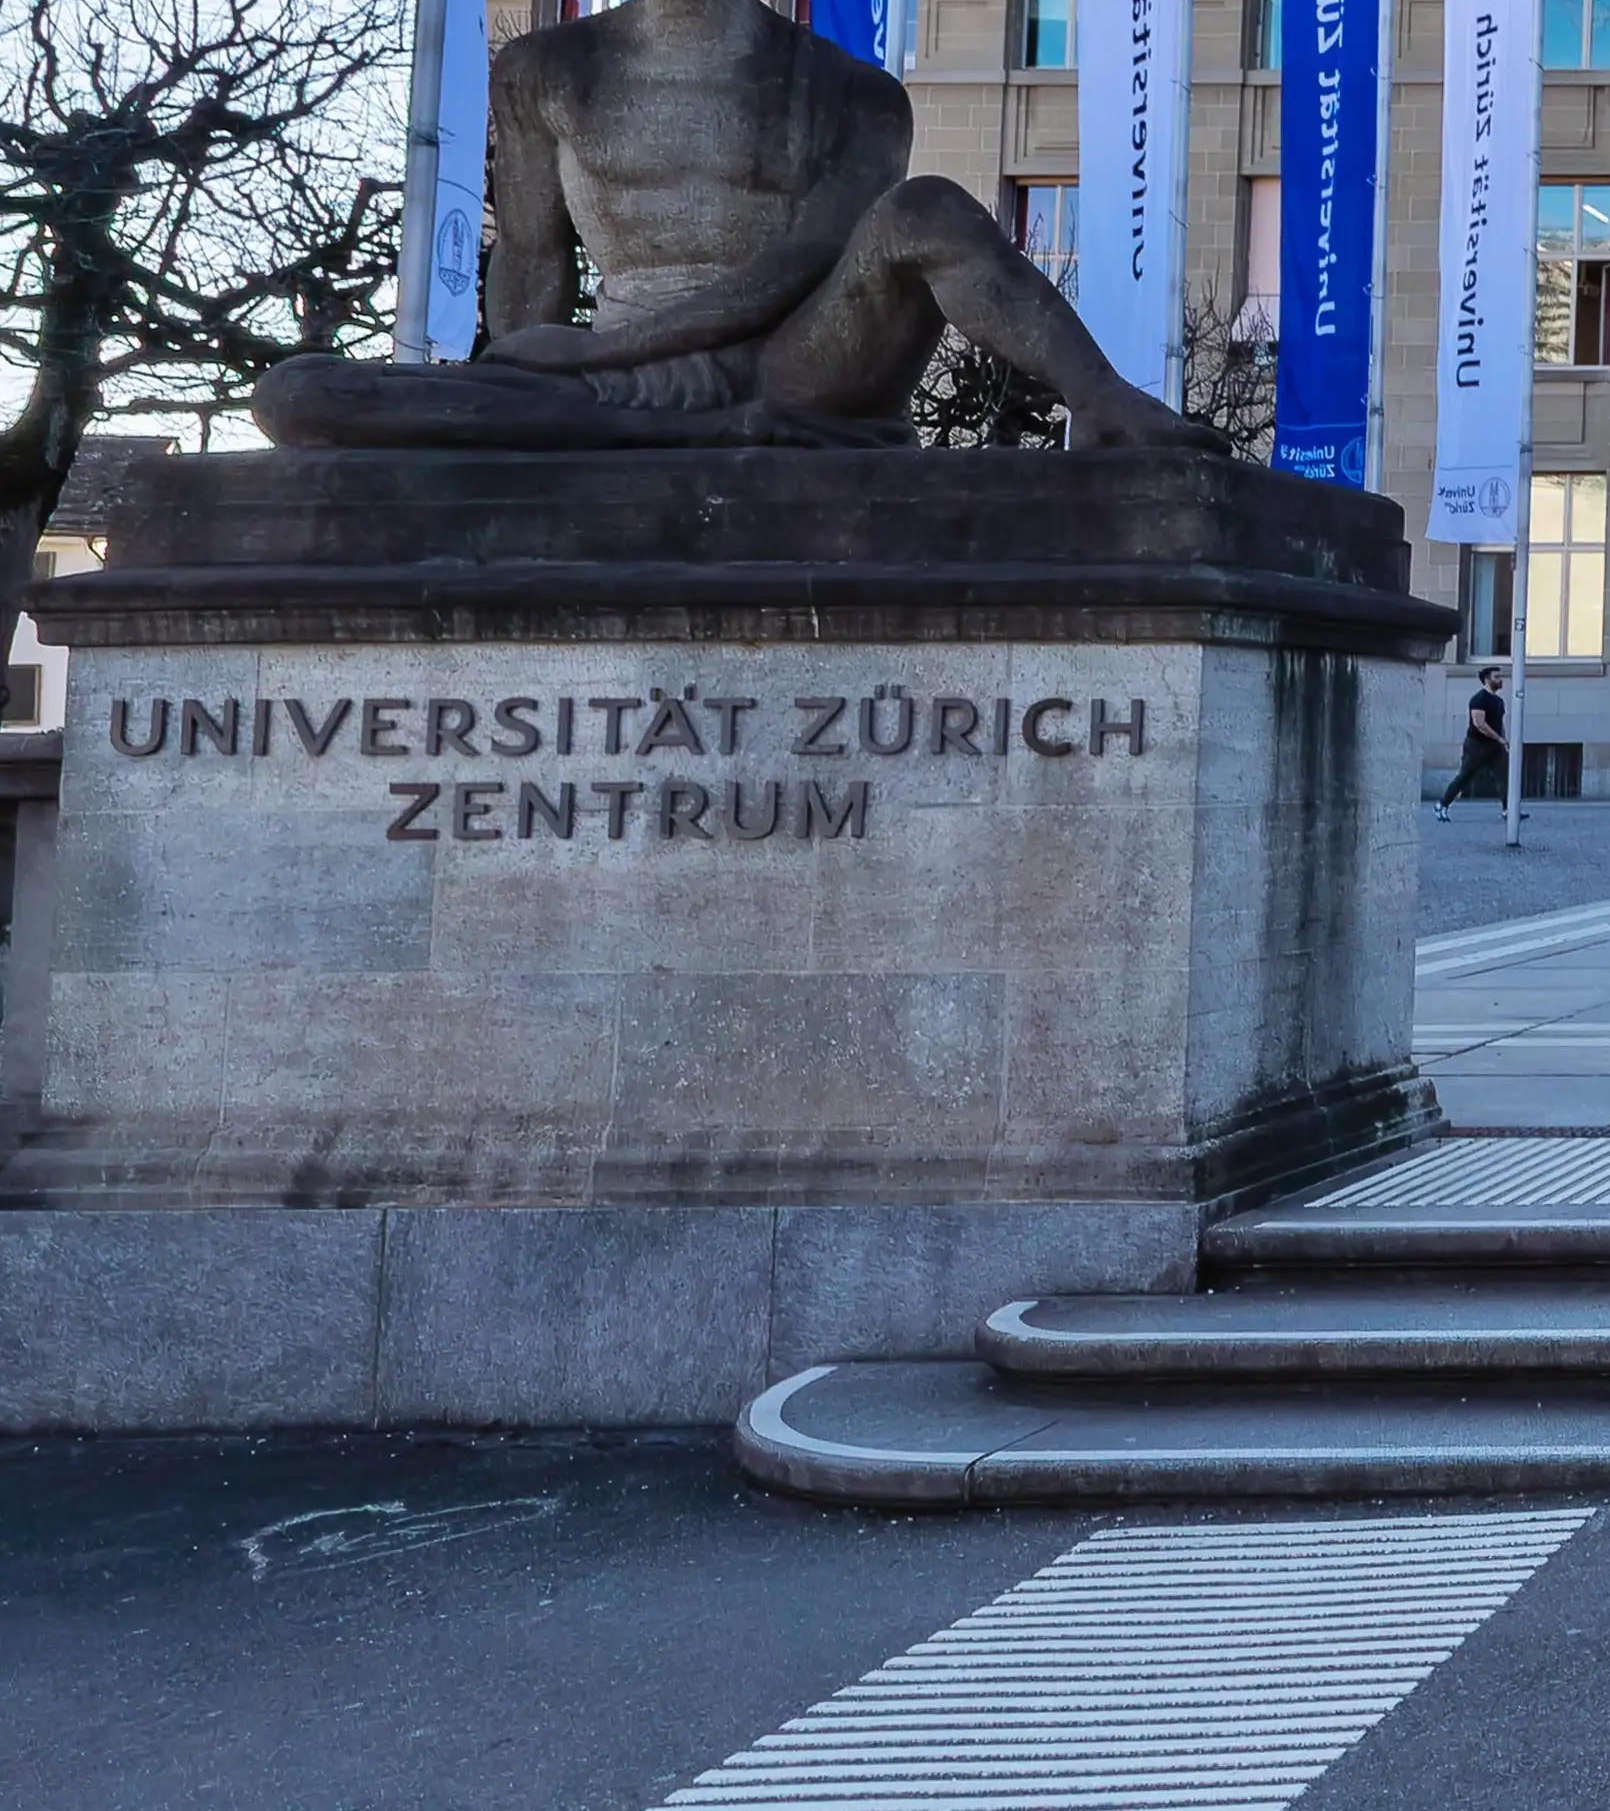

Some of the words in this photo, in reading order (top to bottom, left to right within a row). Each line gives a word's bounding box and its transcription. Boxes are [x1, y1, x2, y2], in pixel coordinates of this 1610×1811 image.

[108, 683, 761, 759] UNIVERSITÄT
[791, 683, 1148, 759] ZÜRICH
[385, 778, 873, 843] ZENTRUM
